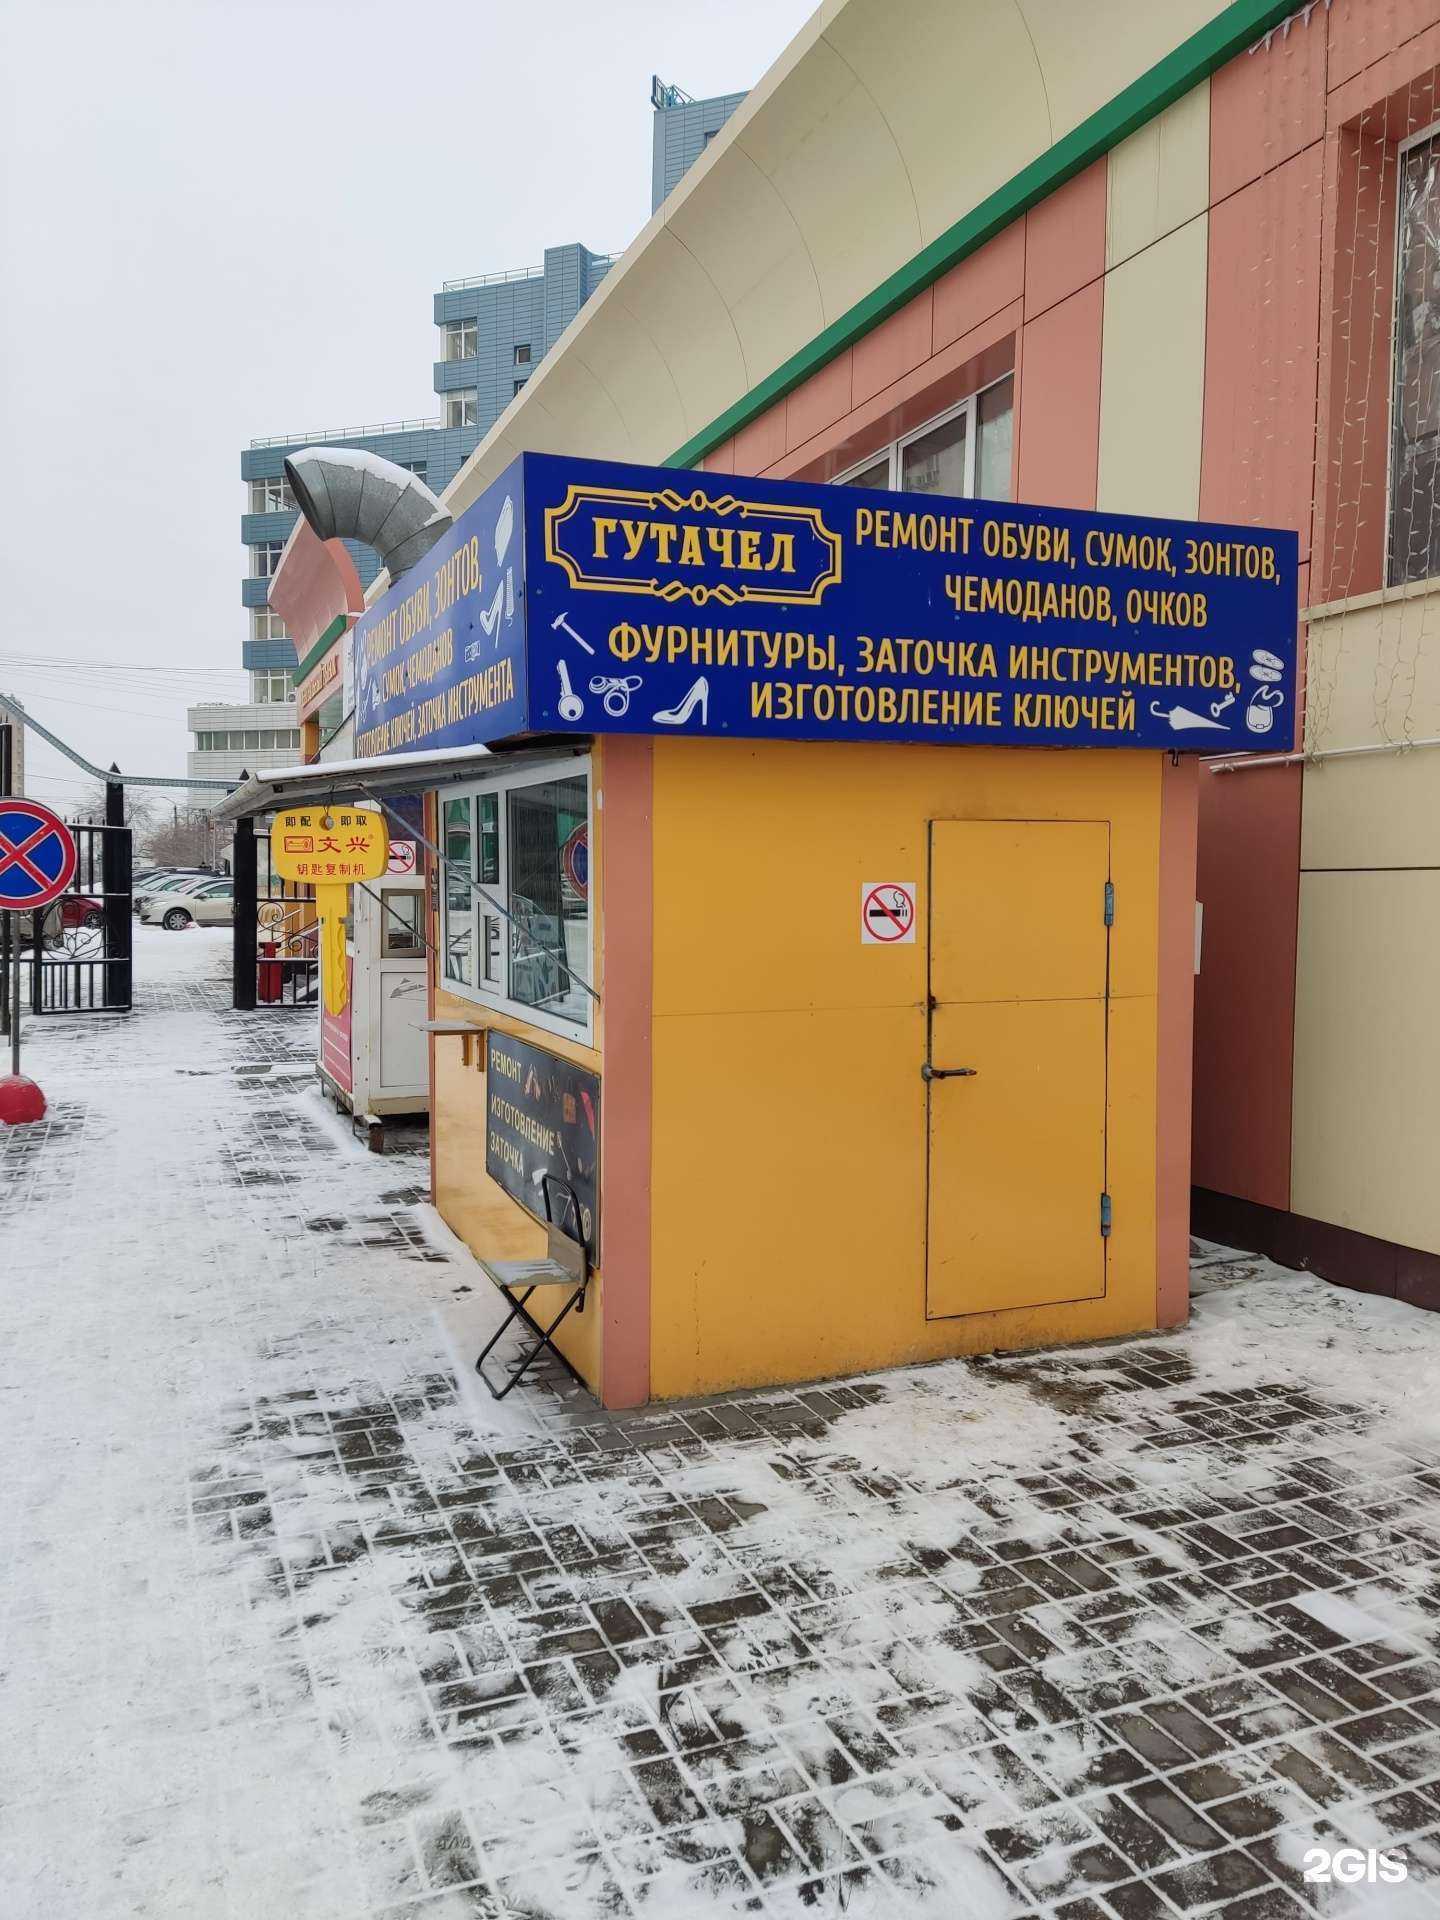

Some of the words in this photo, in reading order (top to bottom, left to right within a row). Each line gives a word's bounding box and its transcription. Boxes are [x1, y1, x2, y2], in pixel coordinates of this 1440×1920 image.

[592, 516, 797, 573] ГУТАЧЕЛ
[855, 507, 974, 555] РЕМОНТ
[982, 520, 1076, 570] ОБУВИ,
[1085, 530, 1177, 577] СУМОК,
[1184, 539, 1281, 586] ЗОНТОВ,
[366, 609, 398, 668] РЕМОНТ
[399, 580, 432, 645] ОБУВИ,
[434, 535, 483, 620] ЗОНТОВ,
[944, 574, 1118, 628] ЧЕМОДАНОВ,
[1126, 588, 1208, 628] ОЧКОВ
[407, 627, 454, 690] ЧЕМОДАНОВ
[608, 622, 846, 677] ФУРНИТУРЫ,
[855, 636, 998, 679] ЗАТОЧКА
[1008, 645, 1241, 694] ИНСТРУМЕНТОВ,
[417, 690, 447, 738] ЗАТОЧКА
[448, 656, 514, 724] ИНСТРУМЕНТА
[750, 680, 1002, 728] ИЗГОТОВЛЕНИЕ
[1012, 690, 1136, 731] КЛЮЧЕЙ
[297, 863, 366, 876] 钥匙复制机
[317, 836, 370, 853] 文兴
[490, 1048, 522, 1083] РЕМОНТ
[491, 1093, 555, 1156] ИЗГОТОВЛЕНИЕ
[490, 1131, 524, 1177] ЗАТОЧКА
